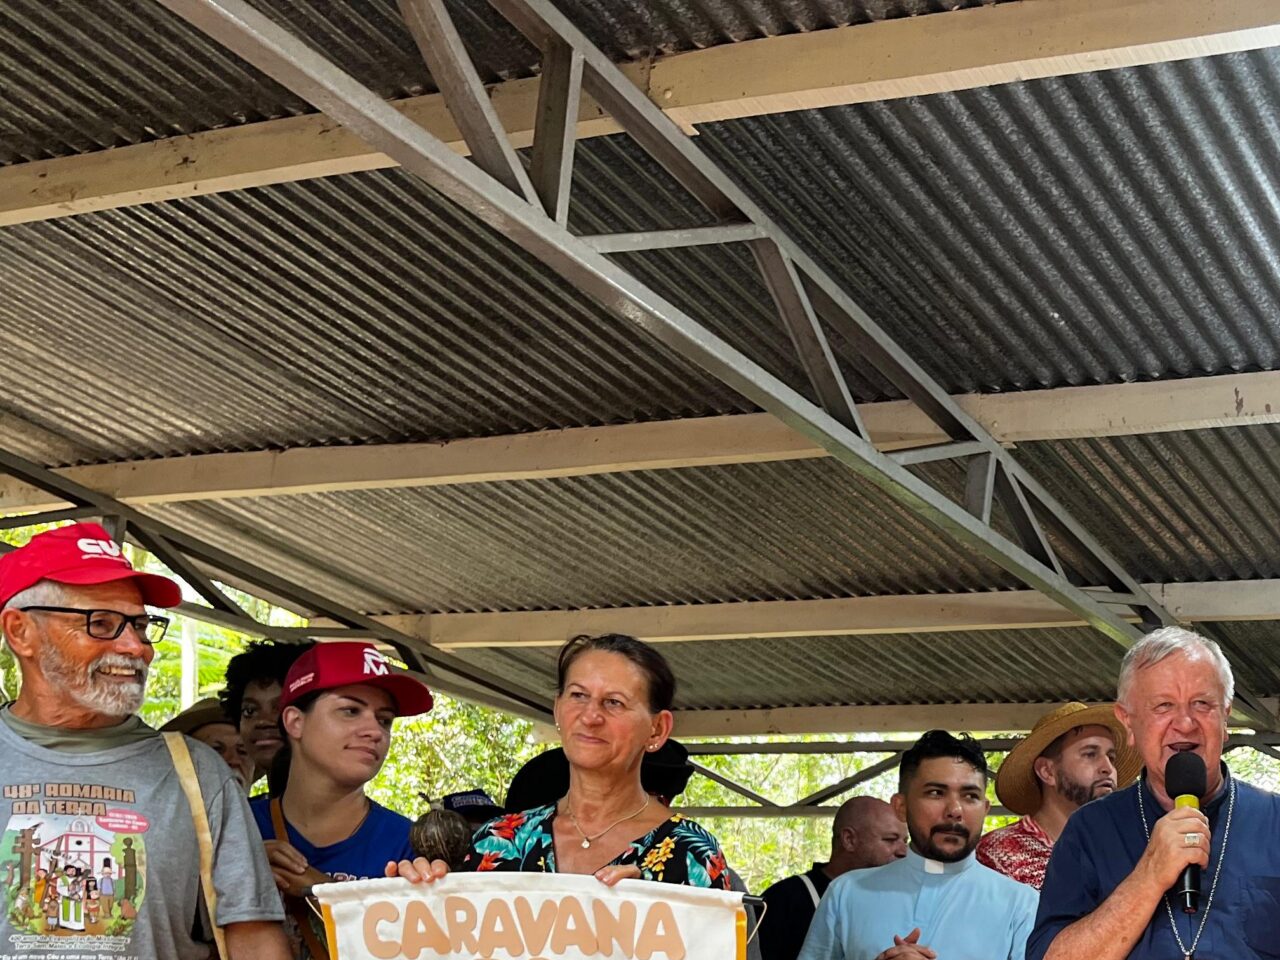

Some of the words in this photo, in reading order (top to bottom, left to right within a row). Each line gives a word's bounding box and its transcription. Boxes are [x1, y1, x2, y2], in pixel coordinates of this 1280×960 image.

[44, 783, 136, 803] ROMARIA
[12, 801, 41, 815] DA
[43, 800, 107, 816] TERRA
